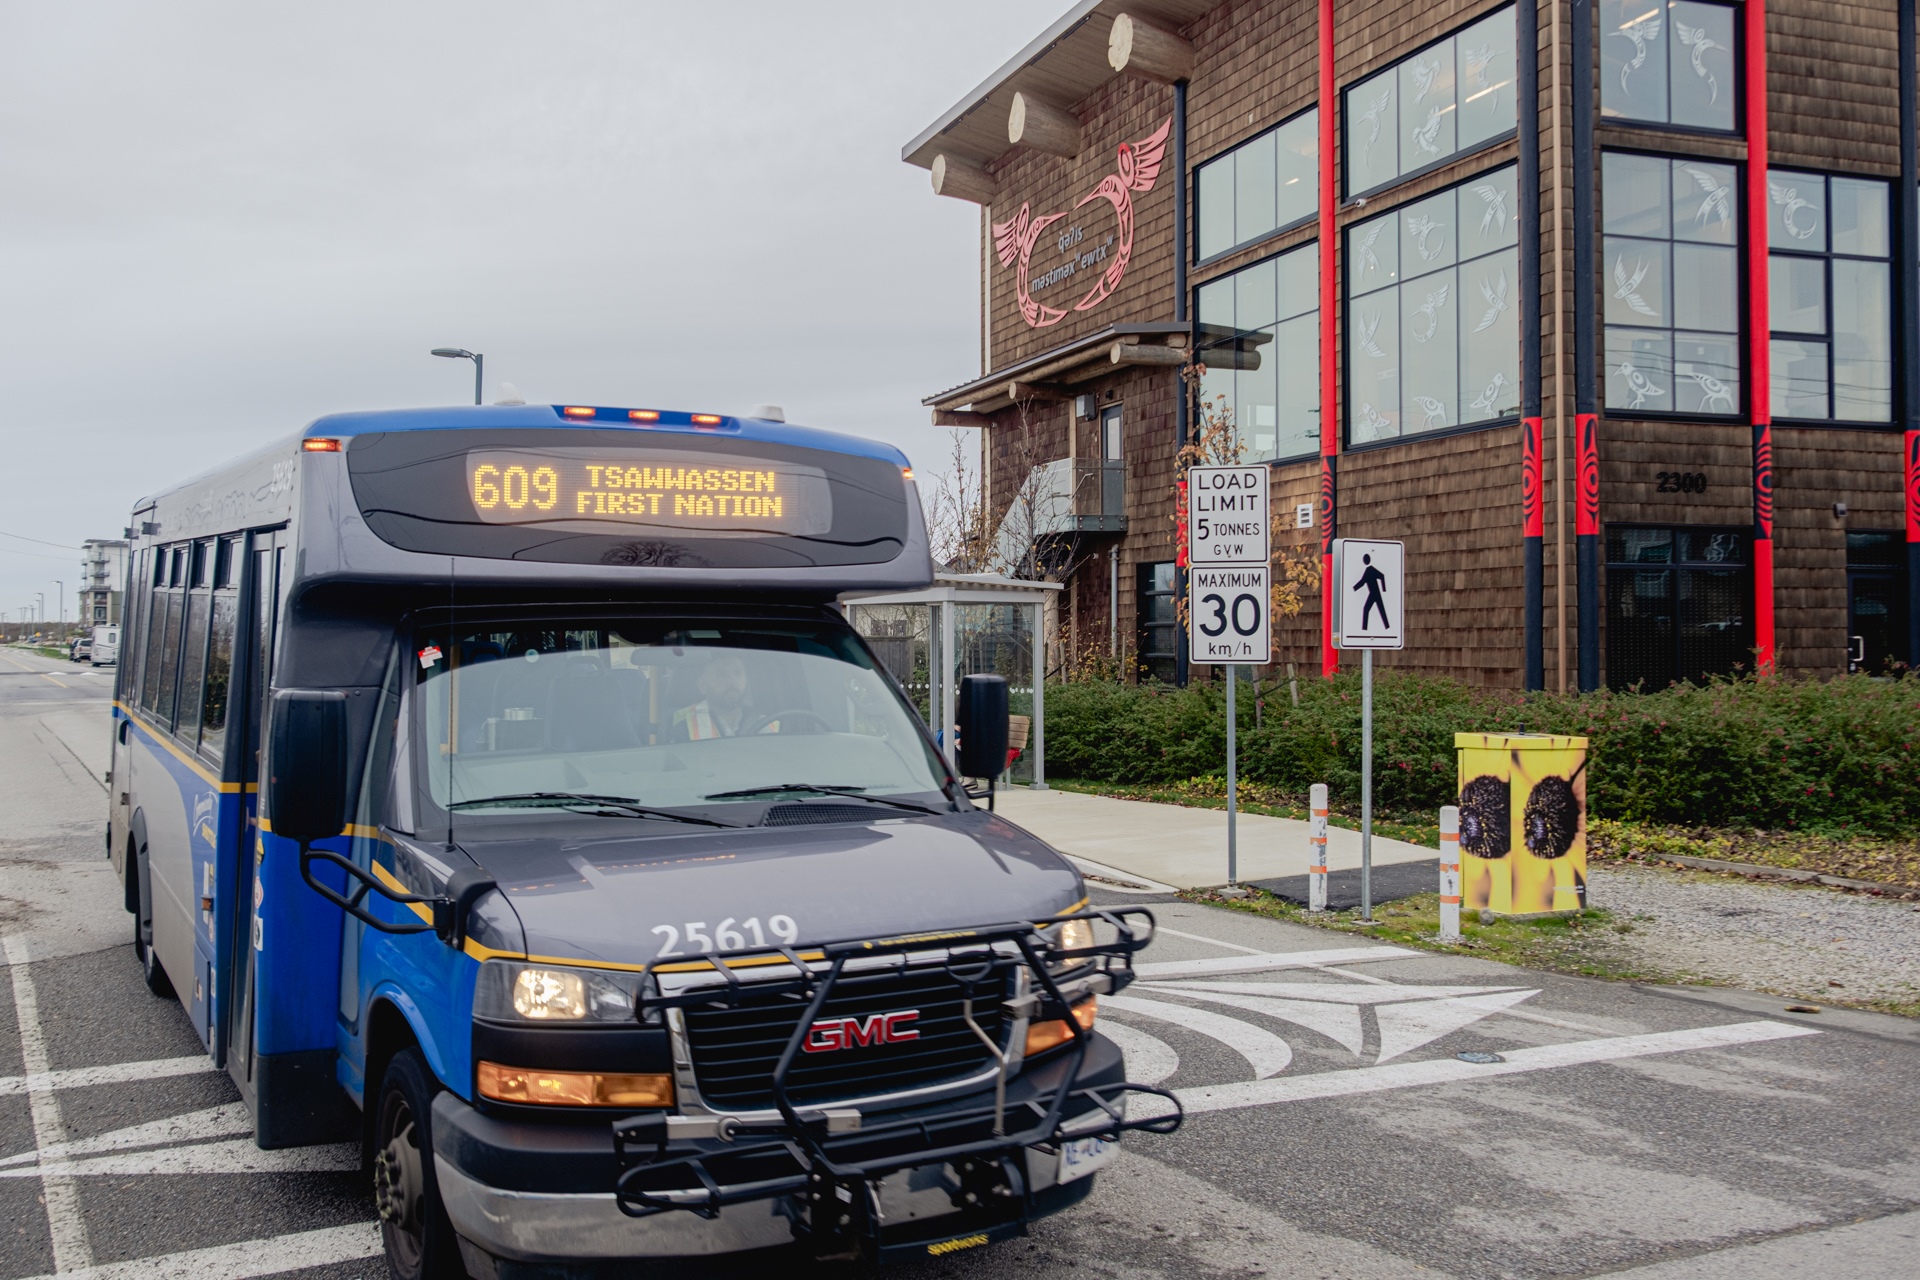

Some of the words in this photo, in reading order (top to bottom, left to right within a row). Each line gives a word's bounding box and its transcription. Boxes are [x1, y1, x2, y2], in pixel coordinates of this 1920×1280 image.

[474, 465, 557, 509] 609
[586, 465, 775, 492] TSAWWASSEN
[1198, 473, 1257, 490] LOAD
[1656, 471, 1707, 494] 2300
[576, 491, 664, 515] FIRST
[674, 494, 783, 518] NATION
[1198, 494, 1258, 512] LIMIT
[1197, 518, 1210, 541] 5
[1213, 522, 1260, 537] TONNES
[1198, 573, 1262, 588] MAXIMUM
[1199, 593, 1261, 637] 30
[1208, 641, 1252, 656] km/h
[651, 914, 799, 958] 25619
[802, 1010, 921, 1054] GMC
